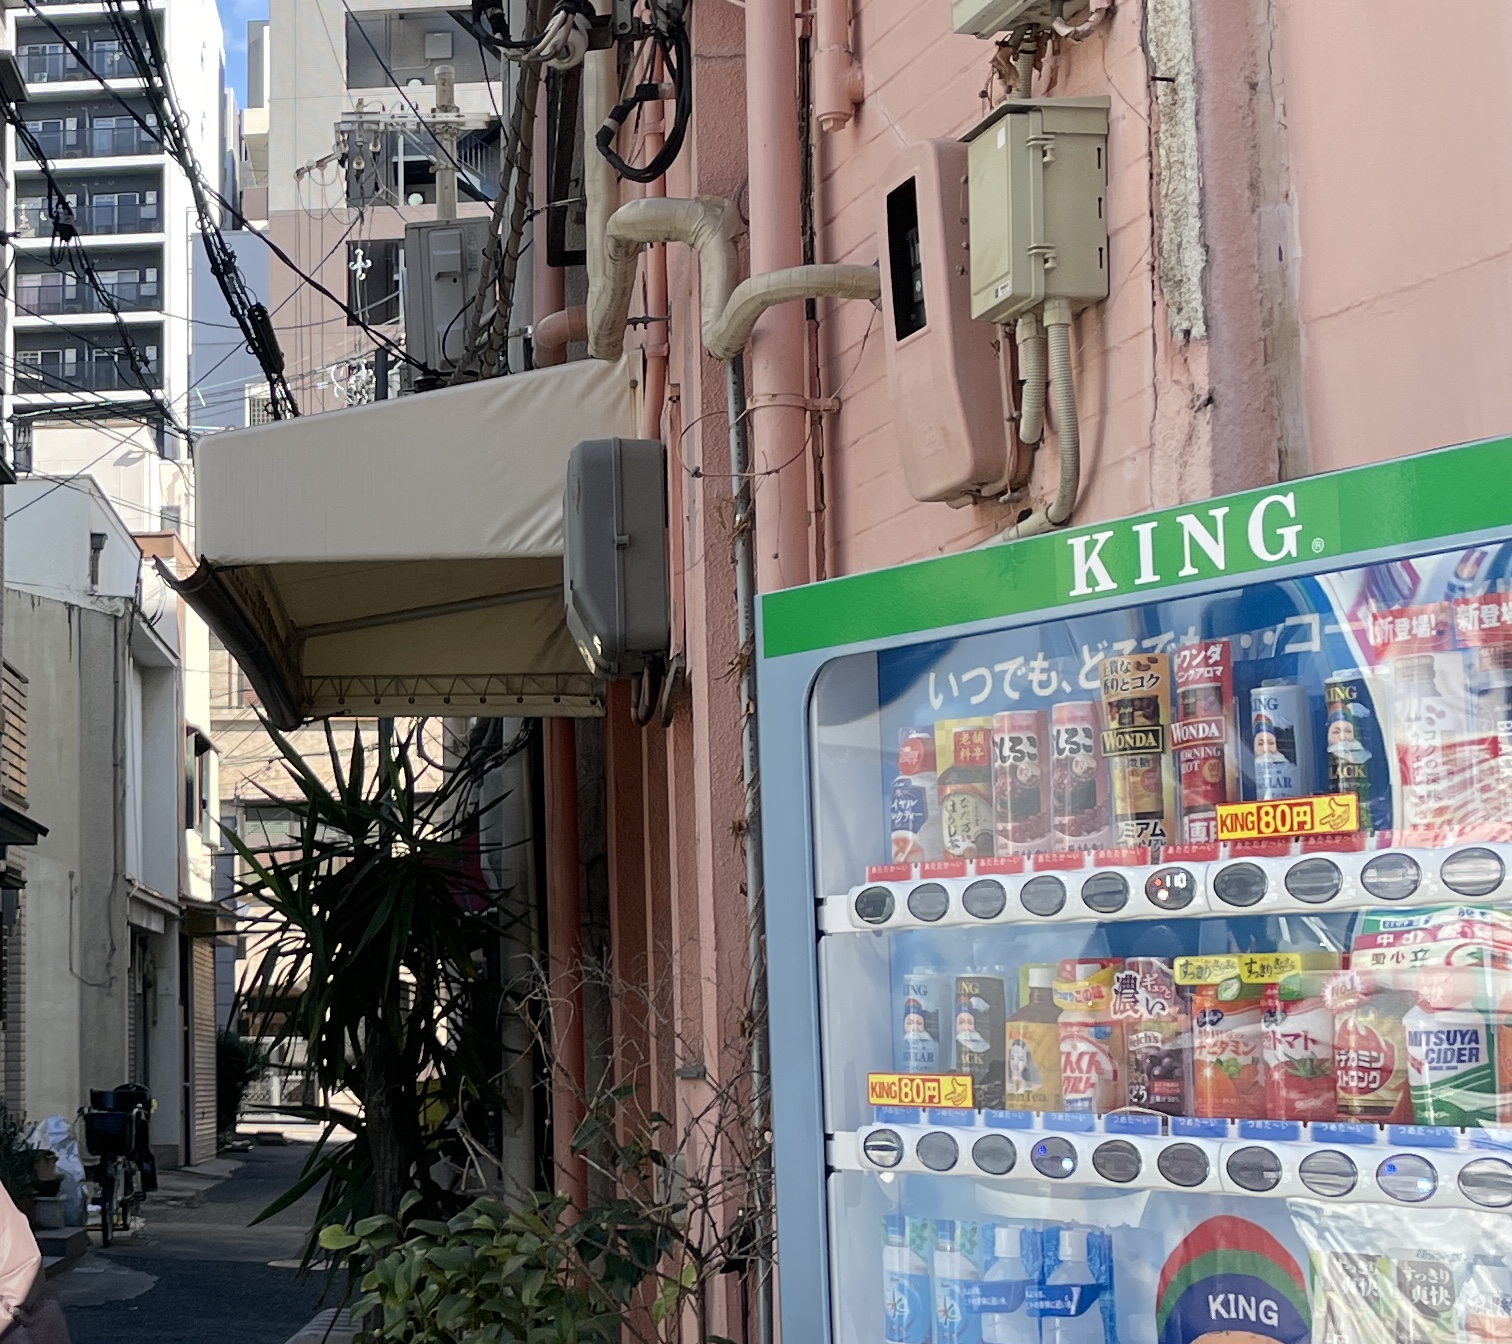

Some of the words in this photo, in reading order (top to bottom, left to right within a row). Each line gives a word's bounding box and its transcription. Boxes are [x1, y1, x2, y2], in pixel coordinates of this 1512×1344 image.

[1067, 491, 1305, 598] KING
[1102, 730, 1158, 753] WONDA
[1170, 722, 1221, 745] WONDA
[1220, 810, 1257, 834] KING
[1259, 803, 1313, 835] 80円
[1408, 1029, 1481, 1047] MITSUYA
[1425, 1047, 1480, 1065] CIDER
[871, 1080, 898, 1100] KING
[899, 1078, 939, 1104] 80円
[1402, 1267, 1451, 1285] すっきり
[1411, 1286, 1452, 1308] 爽快
[1207, 1293, 1279, 1327] KING
